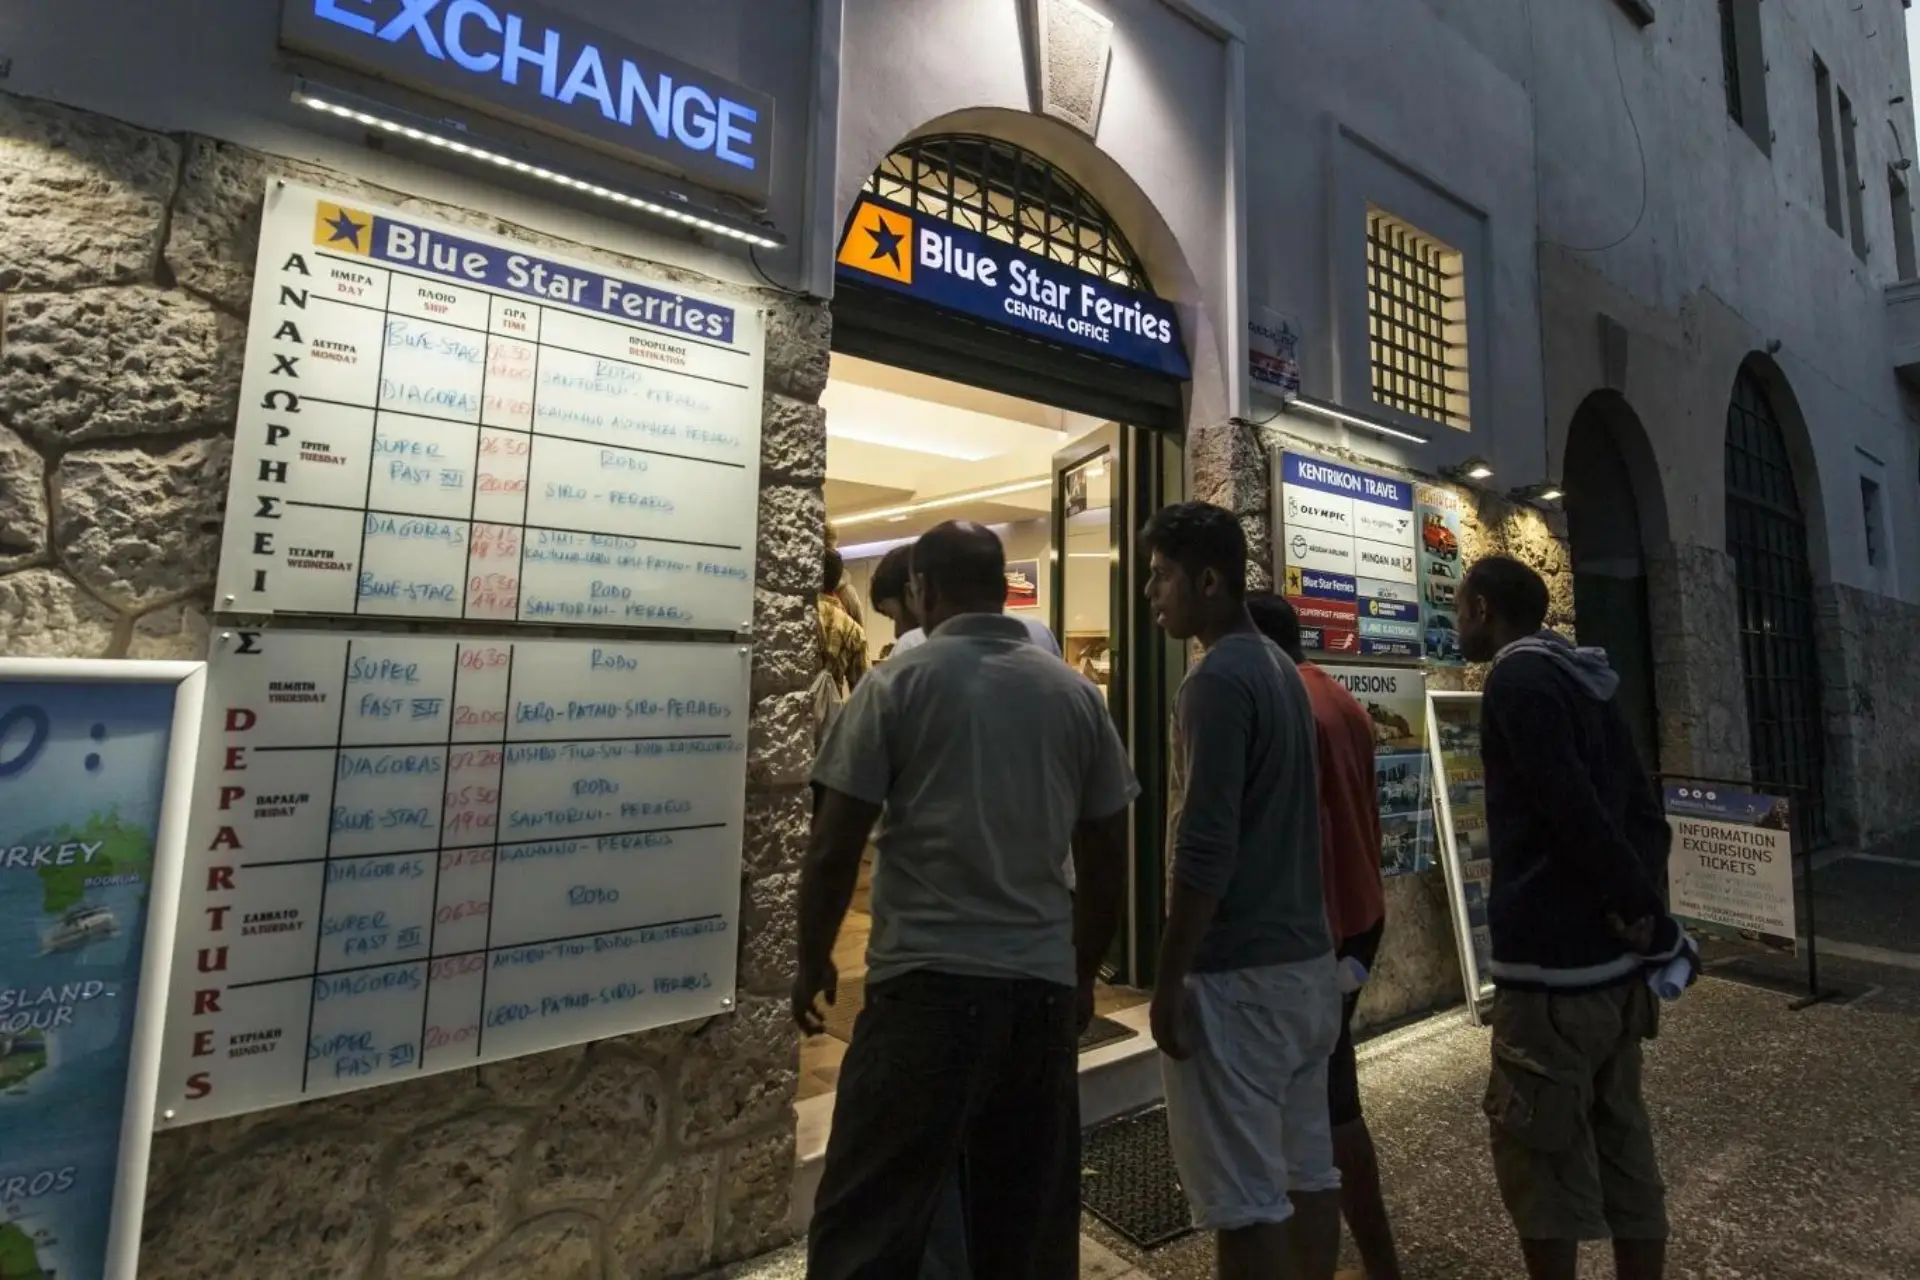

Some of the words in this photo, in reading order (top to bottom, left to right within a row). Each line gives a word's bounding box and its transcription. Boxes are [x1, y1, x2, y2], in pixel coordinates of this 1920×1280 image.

[337, 282, 365, 297] DAY
[386, 224, 489, 278] Blue
[506, 256, 589, 303] Star
[602, 278, 726, 337] Ferries
[919, 227, 998, 288] Blue
[1009, 259, 1070, 311] Star
[1081, 284, 1172, 344] Ferries
[424, 301, 449, 314] SHIP
[1004, 297, 1065, 330] CENTRAL
[1067, 318, 1111, 344] OFFICE
[310, 349, 358, 365] MONDAY
[628, 346, 687, 367] DESTINATION
[299, 452, 347, 465] TUESDAY
[1298, 461, 1361, 494] KENTRIKON
[1365, 477, 1399, 501] TRAVEL
[1301, 505, 1347, 522] OLYMPIC
[287, 558, 353, 572] WEDNESDAY
[1302, 575, 1318, 588] Blue
[1319, 578, 1332, 589] Star
[1300, 607, 1332, 618] SUPERFAST
[348, 655, 420, 682] SUPER
[1334, 675, 1396, 693] CURSIONS
[268, 693, 327, 703] THURSDAY
[254, 806, 295, 818] FRIDAY
[1679, 821, 1775, 849] INFORMATION
[0, 841, 102, 869] RKEY
[1683, 838, 1773, 864] EXCURSIONS
[1700, 854, 1757, 877] TICKETS
[241, 920, 304, 936] SATURDAY
[0, 980, 103, 1011] SLAND
[228, 1041, 277, 1059] SUNDAY
[0, 1166, 76, 1201] ROS
